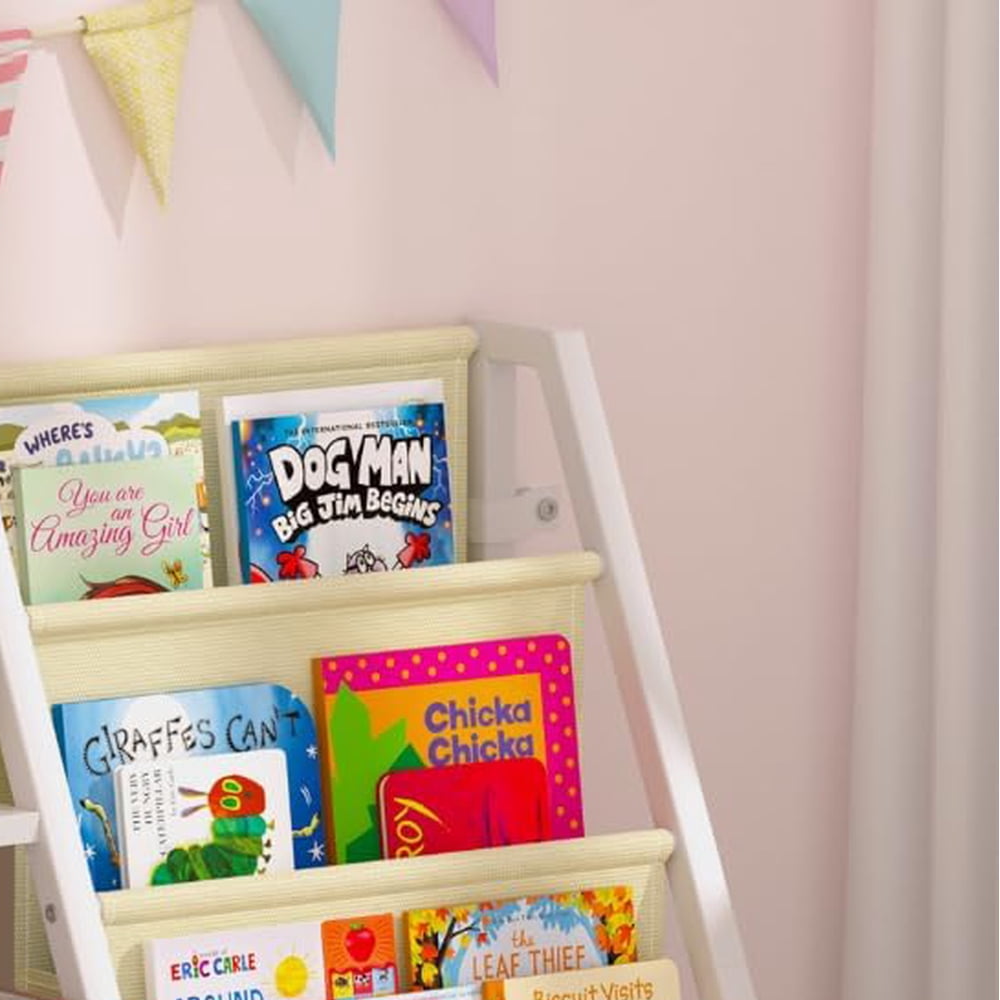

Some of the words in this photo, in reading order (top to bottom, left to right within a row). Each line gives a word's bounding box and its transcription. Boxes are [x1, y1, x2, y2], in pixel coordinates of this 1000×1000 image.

[24, 422, 94, 455] WHERE'S
[268, 436, 351, 502] DOG
[358, 435, 432, 487] MAN
[58, 478, 111, 517] You
[115, 486, 145, 501] are
[111, 508, 133, 521] an
[29, 514, 132, 559] Amazing
[140, 503, 194, 557] Girl
[424, 696, 531, 734] Chicka
[83, 715, 216, 776] GIRAFFES
[226, 704, 300, 752] CAN'T
[428, 730, 534, 767] Chicka
[511, 929, 535, 948] the
[171, 955, 211, 980] ERIC
[213, 953, 256, 976] CARLE
[472, 953, 520, 980] LEAF
[529, 945, 585, 976] THIEF
